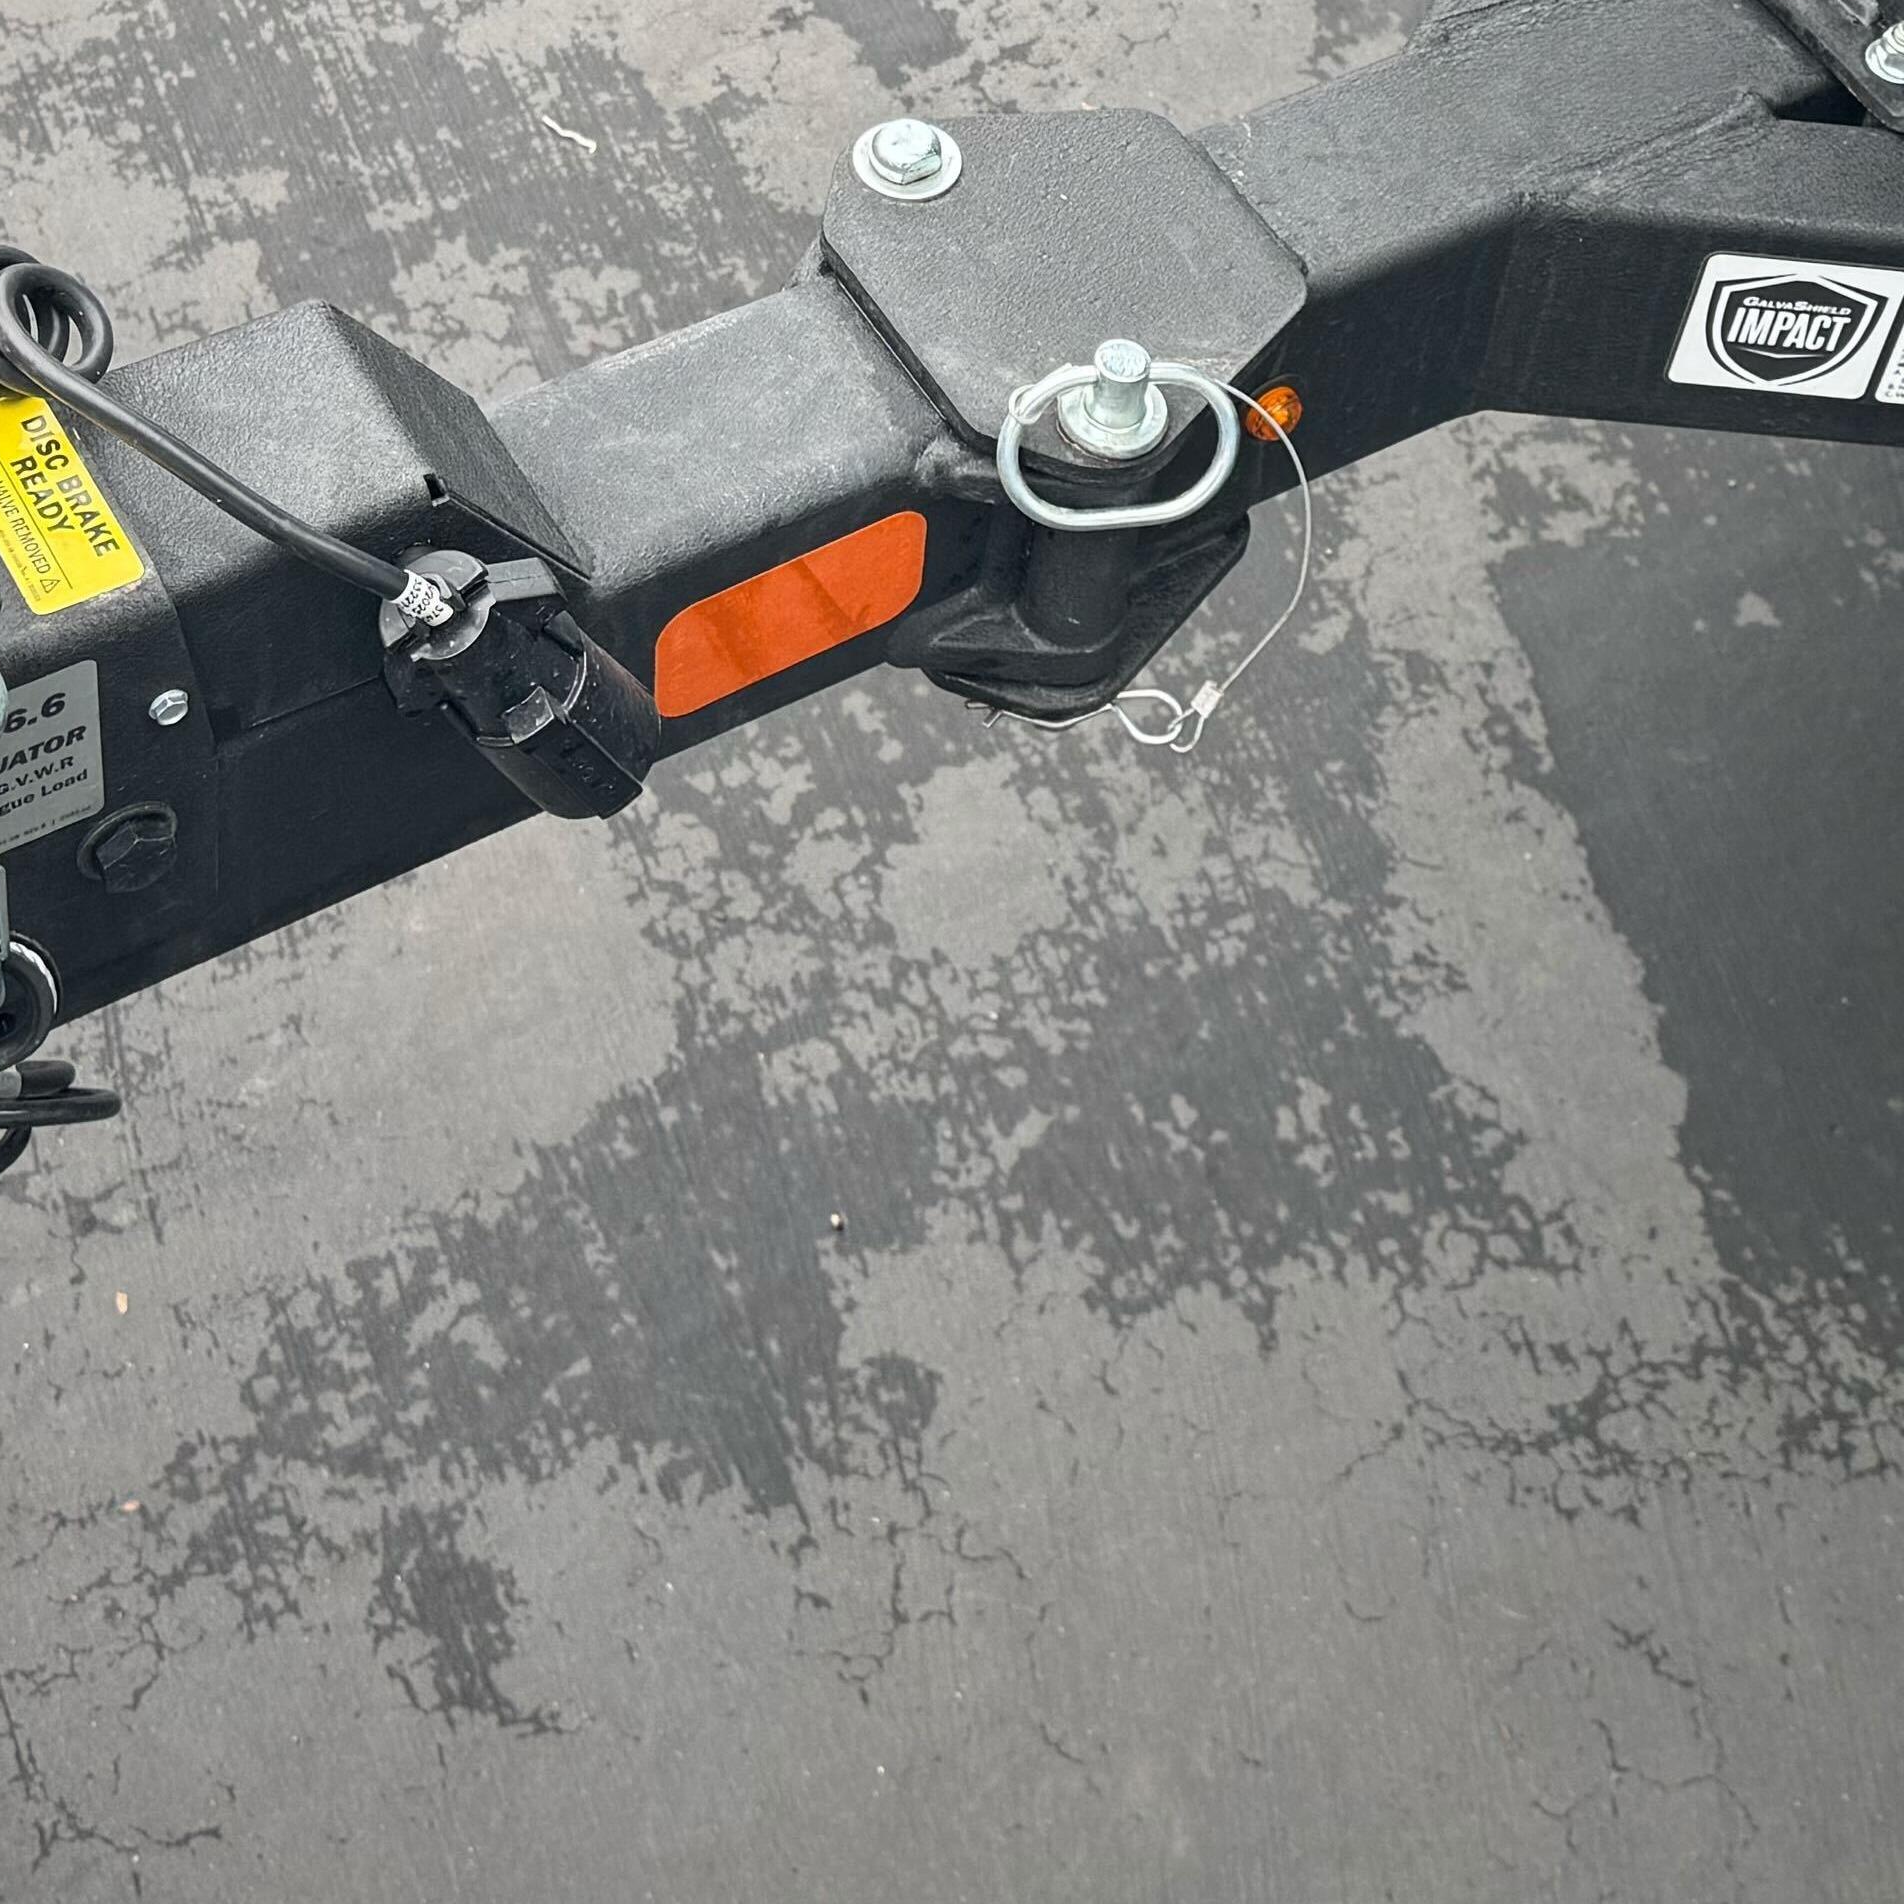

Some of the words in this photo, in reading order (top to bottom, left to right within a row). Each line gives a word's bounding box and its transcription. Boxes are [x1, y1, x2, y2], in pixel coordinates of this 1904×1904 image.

[1726, 306, 1851, 352] IMPACT
[10, 455, 75, 532] READY
[20, 414, 70, 471] DISC
[56, 474, 121, 557] BRAKE
[10, 518, 52, 575] REMOVED
[41, 768, 88, 797] Load
